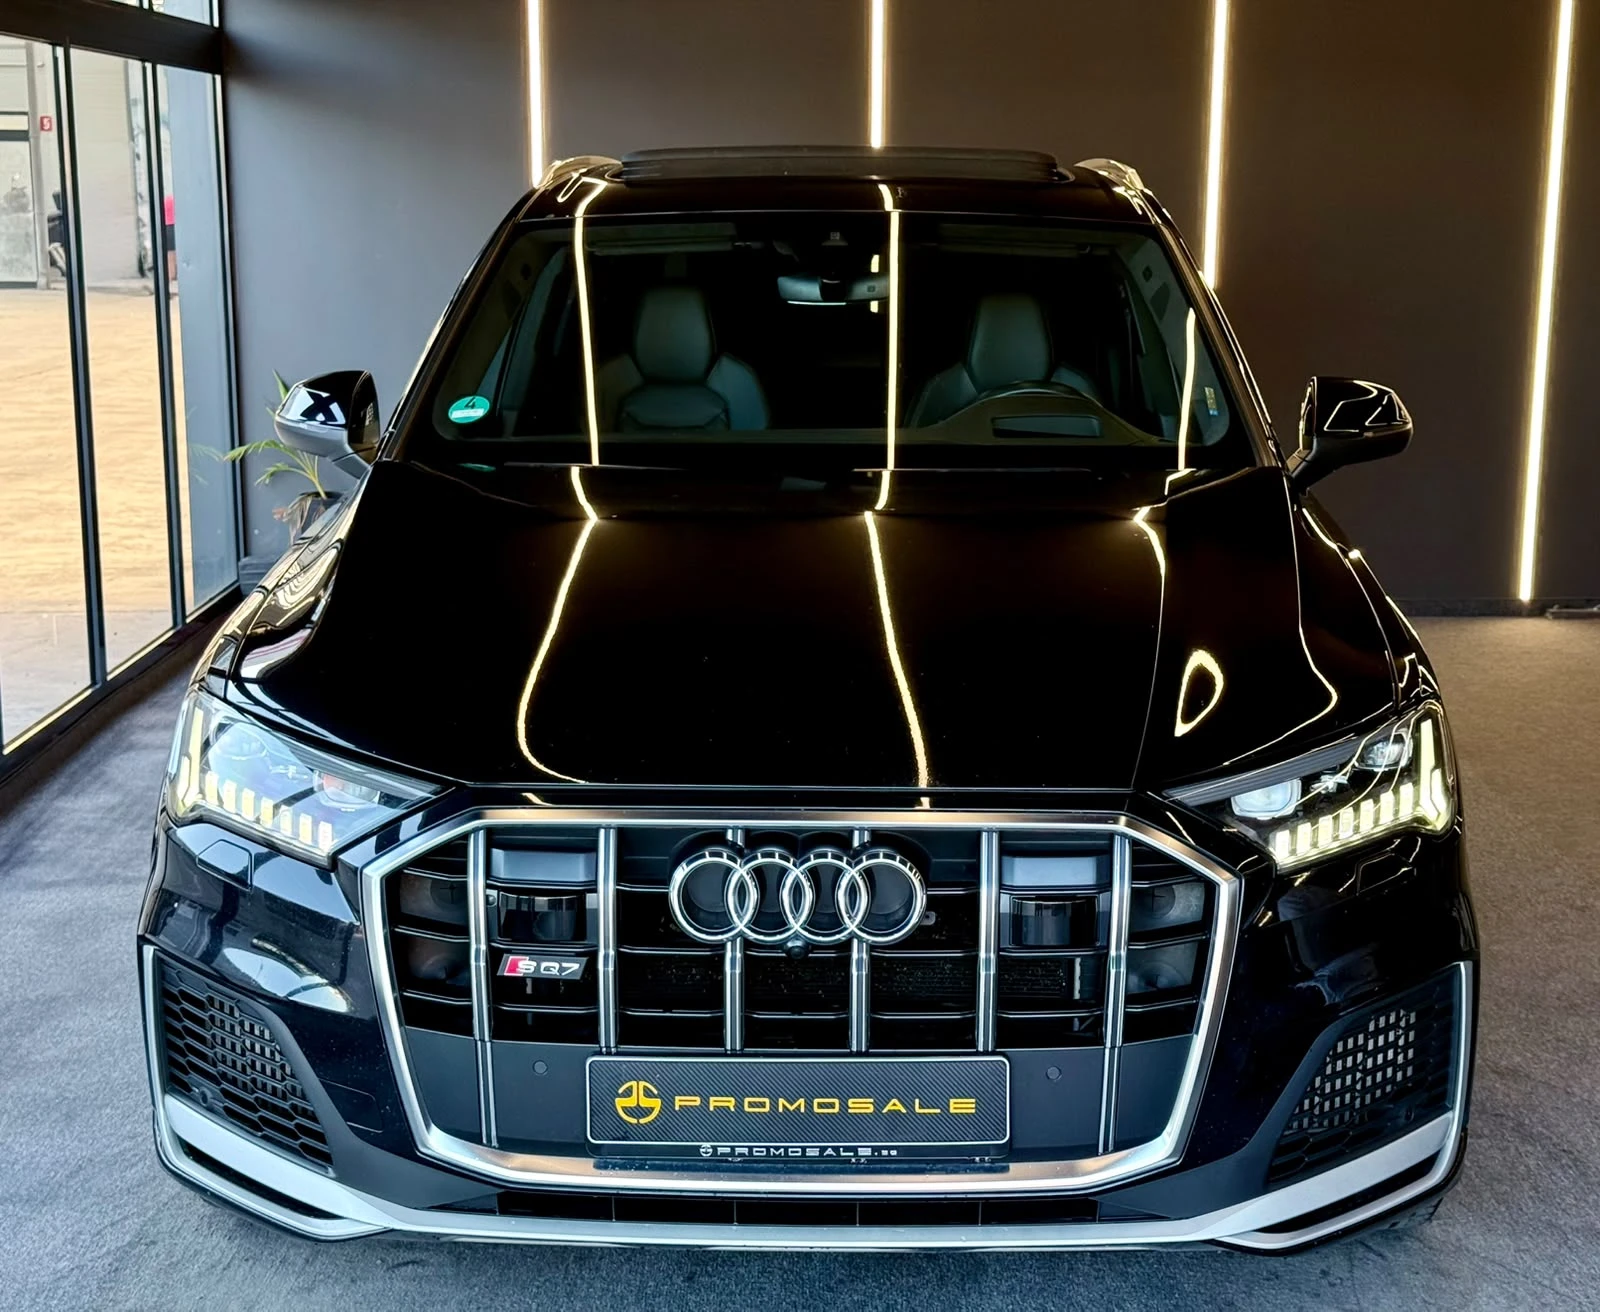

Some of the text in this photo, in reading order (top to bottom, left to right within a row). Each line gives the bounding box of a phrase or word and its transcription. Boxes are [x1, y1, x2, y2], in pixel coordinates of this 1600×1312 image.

[464, 397, 476, 409] 4
[516, 960, 580, 976] SQ7
[674, 1095, 977, 1114] PROMOSALE
